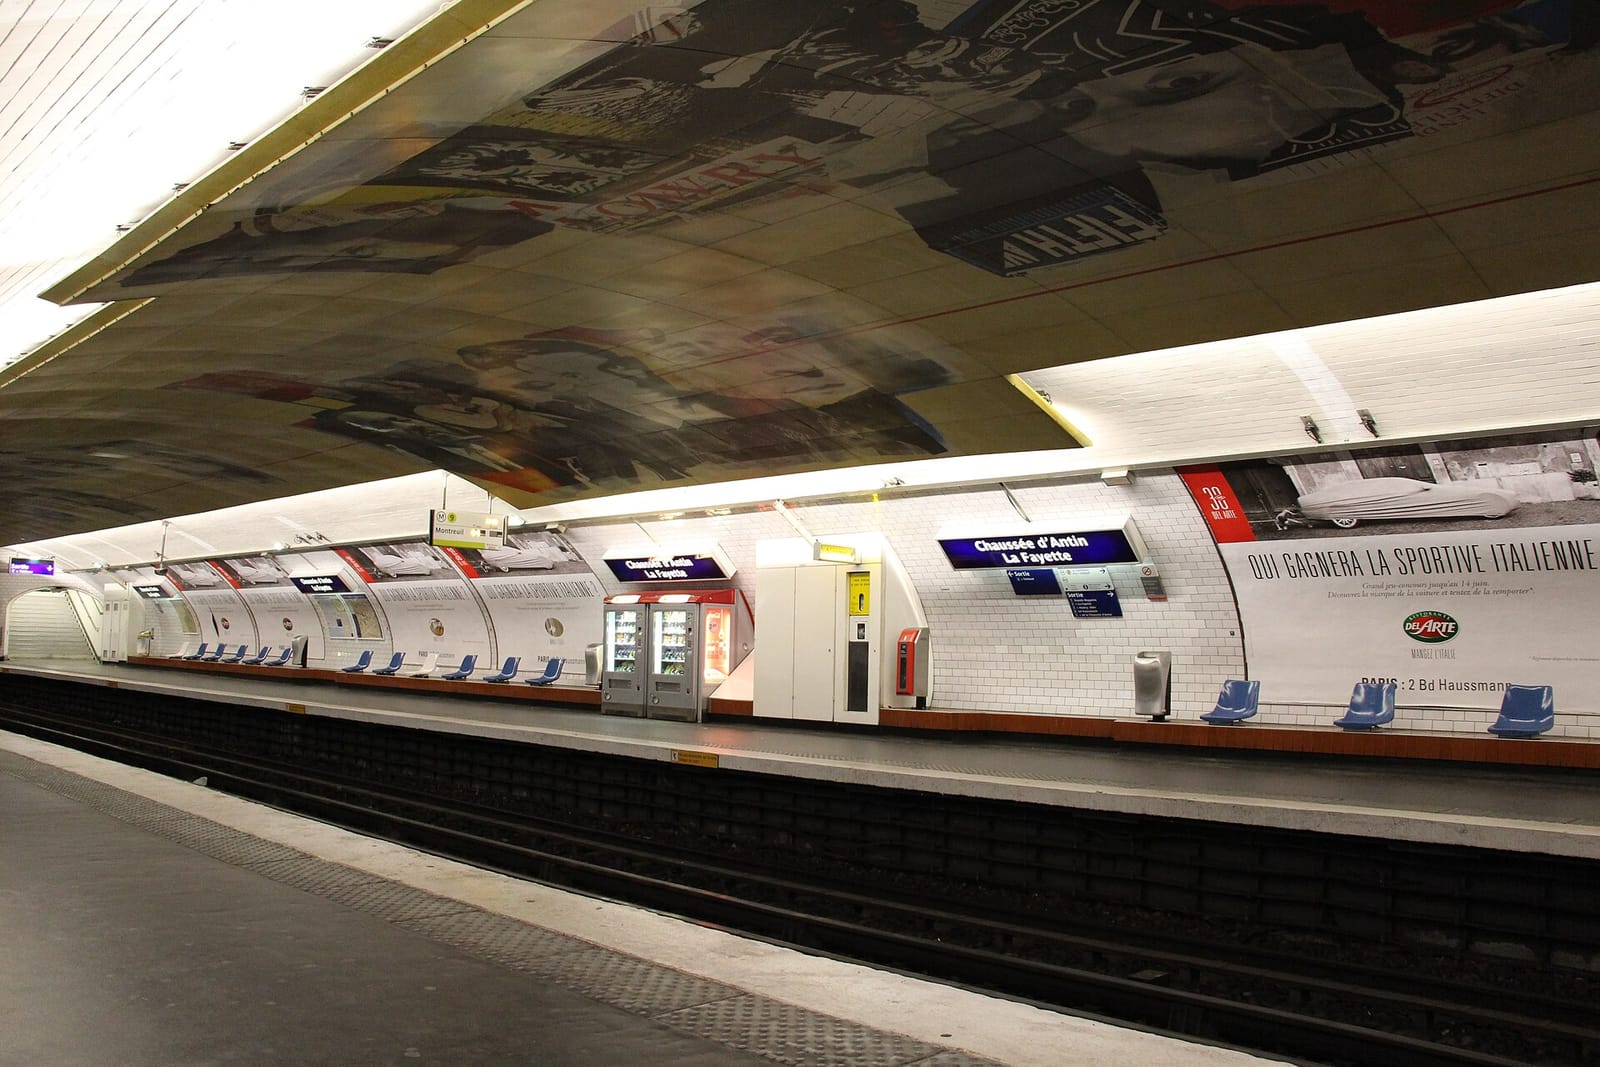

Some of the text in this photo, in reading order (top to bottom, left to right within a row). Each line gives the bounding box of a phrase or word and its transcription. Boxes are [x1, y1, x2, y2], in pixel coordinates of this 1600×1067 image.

[1202, 486, 1229, 510] 30
[435, 527, 464, 535] Montreuil
[974, 537, 1036, 552] Chaussée
[1001, 550, 1073, 565] La Fayette
[1248, 539, 1599, 580] QUI GAGNERA LA SPORTIVE ITALIENNE
[644, 569, 688, 580] La Fayette
[1362, 581, 1385, 589] Grand
[1370, 591, 1398, 599] marque
[1407, 589, 1414, 597] la
[1472, 588, 1481, 596] de
[1483, 587, 1491, 595] la
[1405, 619, 1456, 637] DEL ARTE
[1408, 678, 1416, 691] 2
[1419, 678, 1435, 691] Bd
